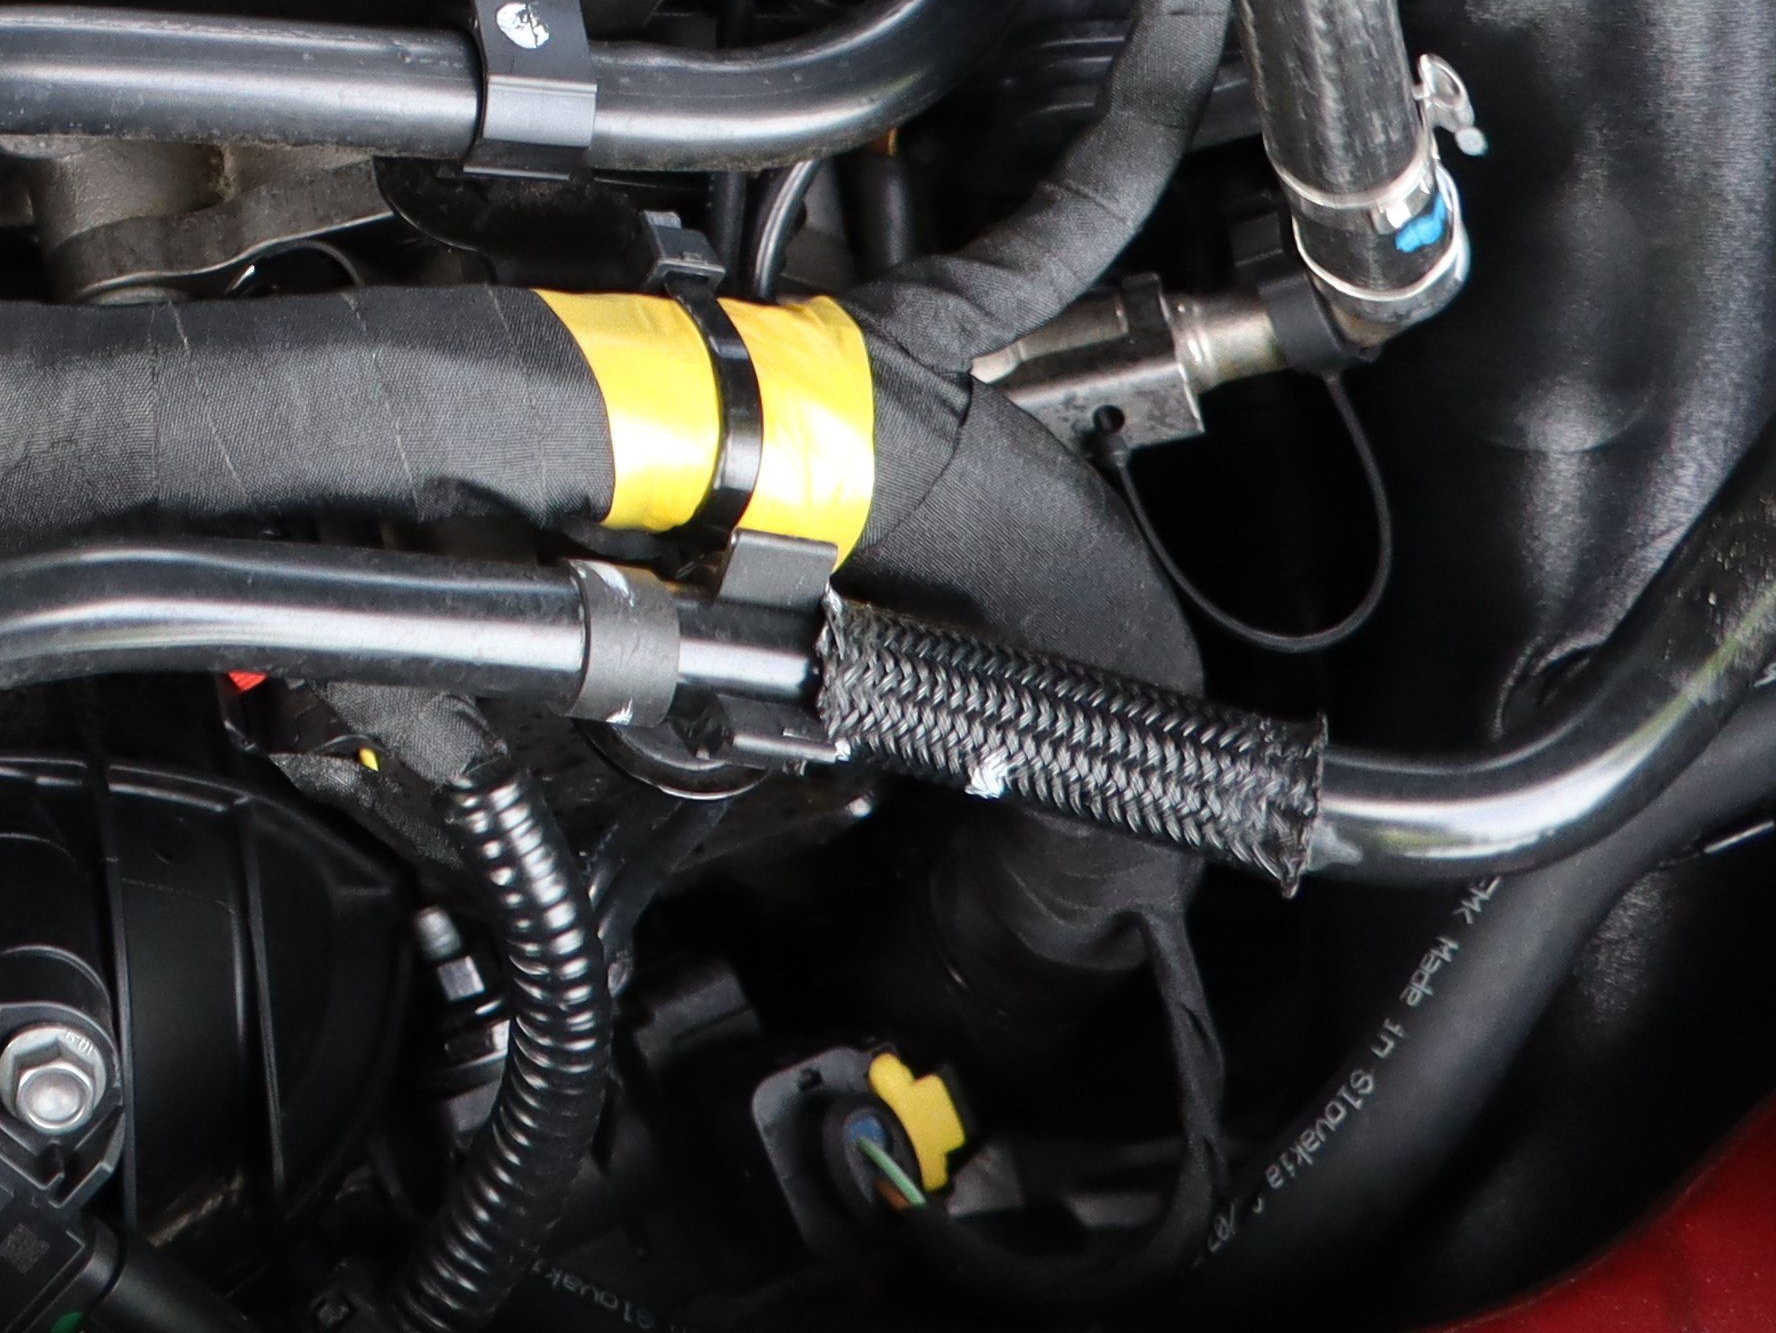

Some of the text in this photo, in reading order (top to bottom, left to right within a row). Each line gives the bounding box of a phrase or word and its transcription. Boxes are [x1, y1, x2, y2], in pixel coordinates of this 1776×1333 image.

[1399, 937, 1461, 1008] Made
[1372, 1016, 1408, 1060] in
[1266, 1069, 1376, 1189] Slovakia
